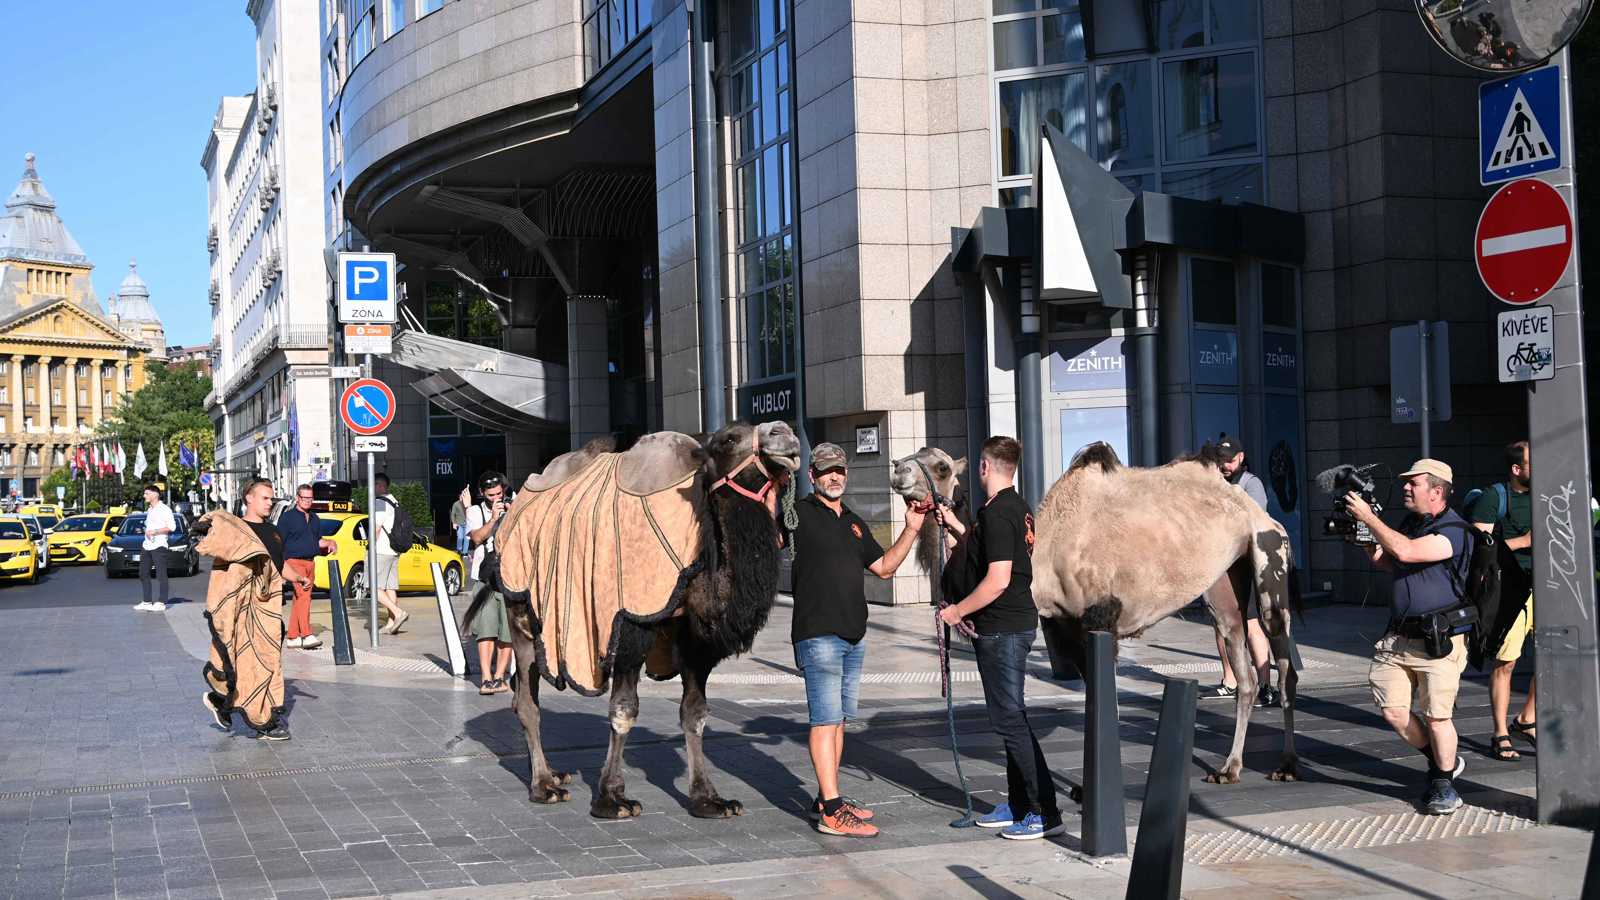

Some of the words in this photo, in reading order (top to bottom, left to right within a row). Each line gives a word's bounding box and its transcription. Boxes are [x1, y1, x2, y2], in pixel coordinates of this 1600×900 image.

[354, 266, 380, 295] P
[351, 306, 384, 318] ZÓNA
[1502, 313, 1549, 337] KIVÉVE
[1066, 356, 1122, 372] ZENITH
[1199, 350, 1233, 366] ZENITH
[1265, 352, 1295, 369] ZENITH
[752, 390, 791, 415] HUBLOT
[436, 462, 453, 475] FOX
